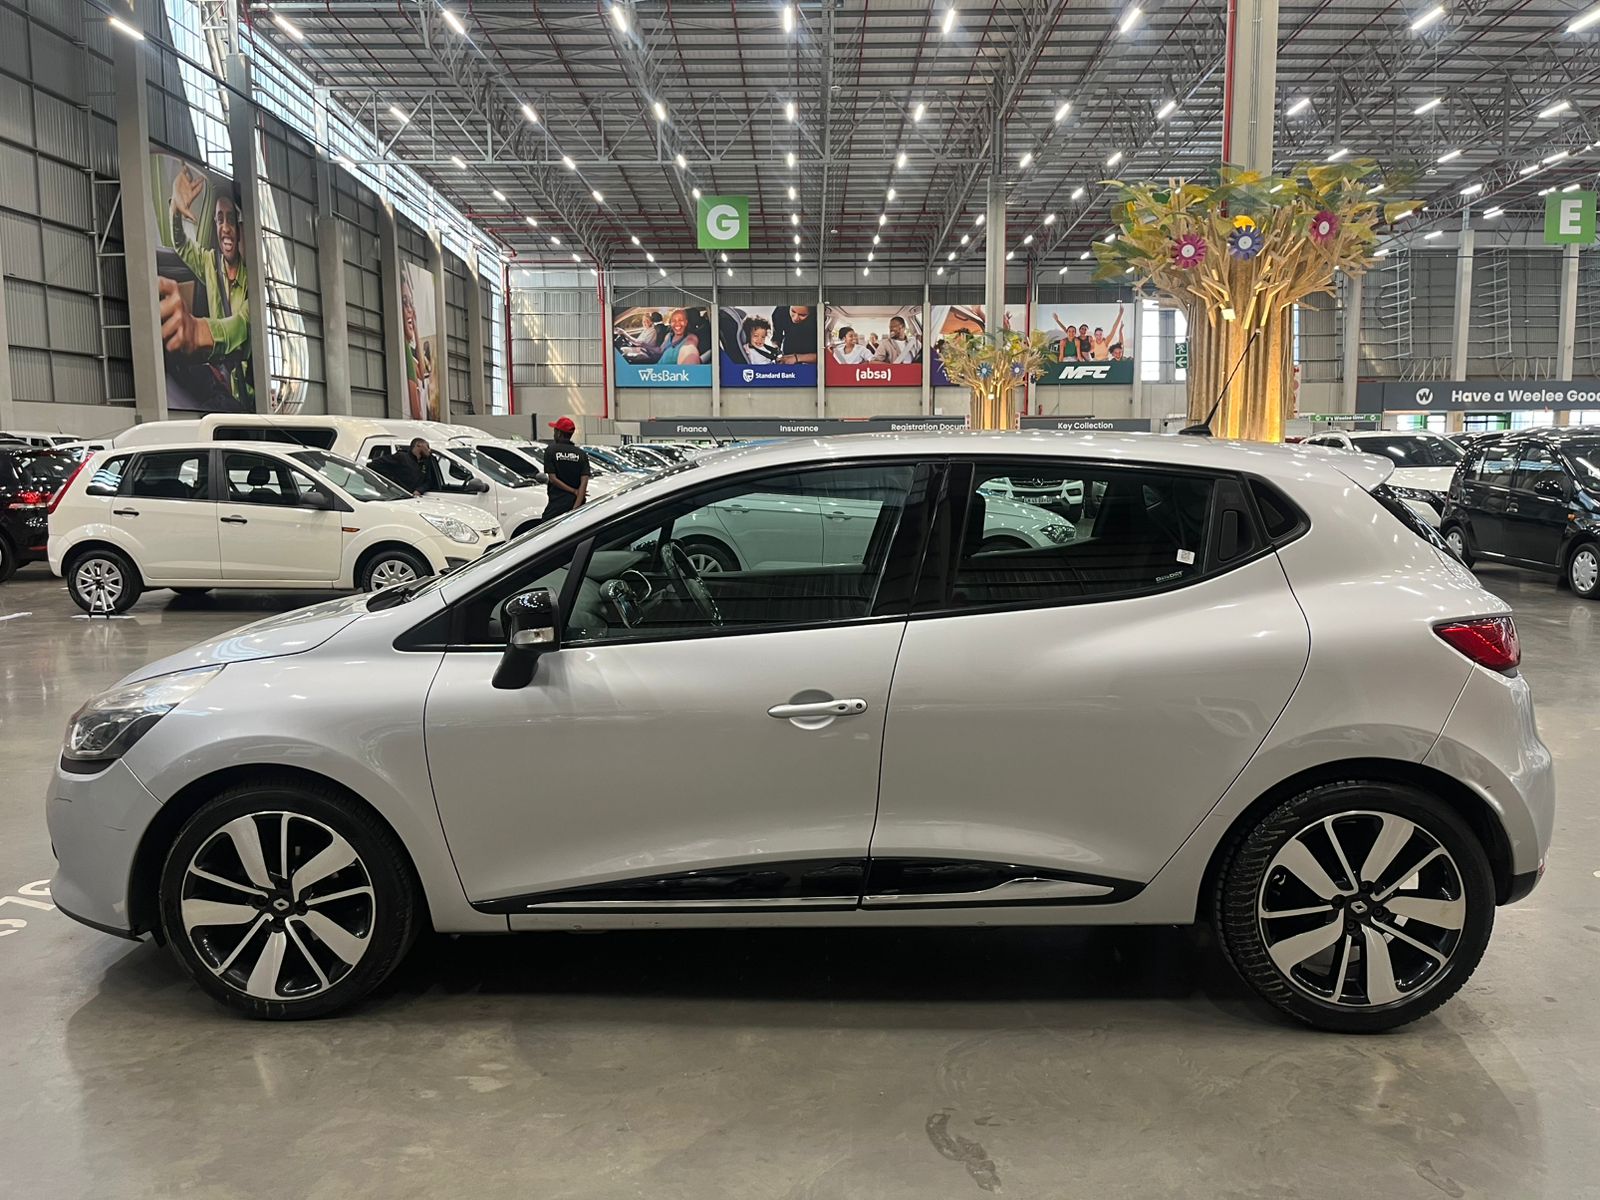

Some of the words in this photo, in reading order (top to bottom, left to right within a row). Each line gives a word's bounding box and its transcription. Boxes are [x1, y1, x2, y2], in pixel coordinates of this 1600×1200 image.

[706, 204, 739, 240] G
[1560, 200, 1582, 234] E
[638, 368, 689, 382] WesBank
[1058, 366, 1111, 379] MFC
[1452, 390, 1491, 402] Have
[1494, 392, 1504, 402] a
[1508, 389, 1564, 402] Weelee
[676, 425, 708, 433] Finance
[780, 424, 819, 432] Insurance
[891, 423, 938, 432] Registration
[1057, 422, 1073, 430] Key
[1073, 421, 1114, 429] Collection
